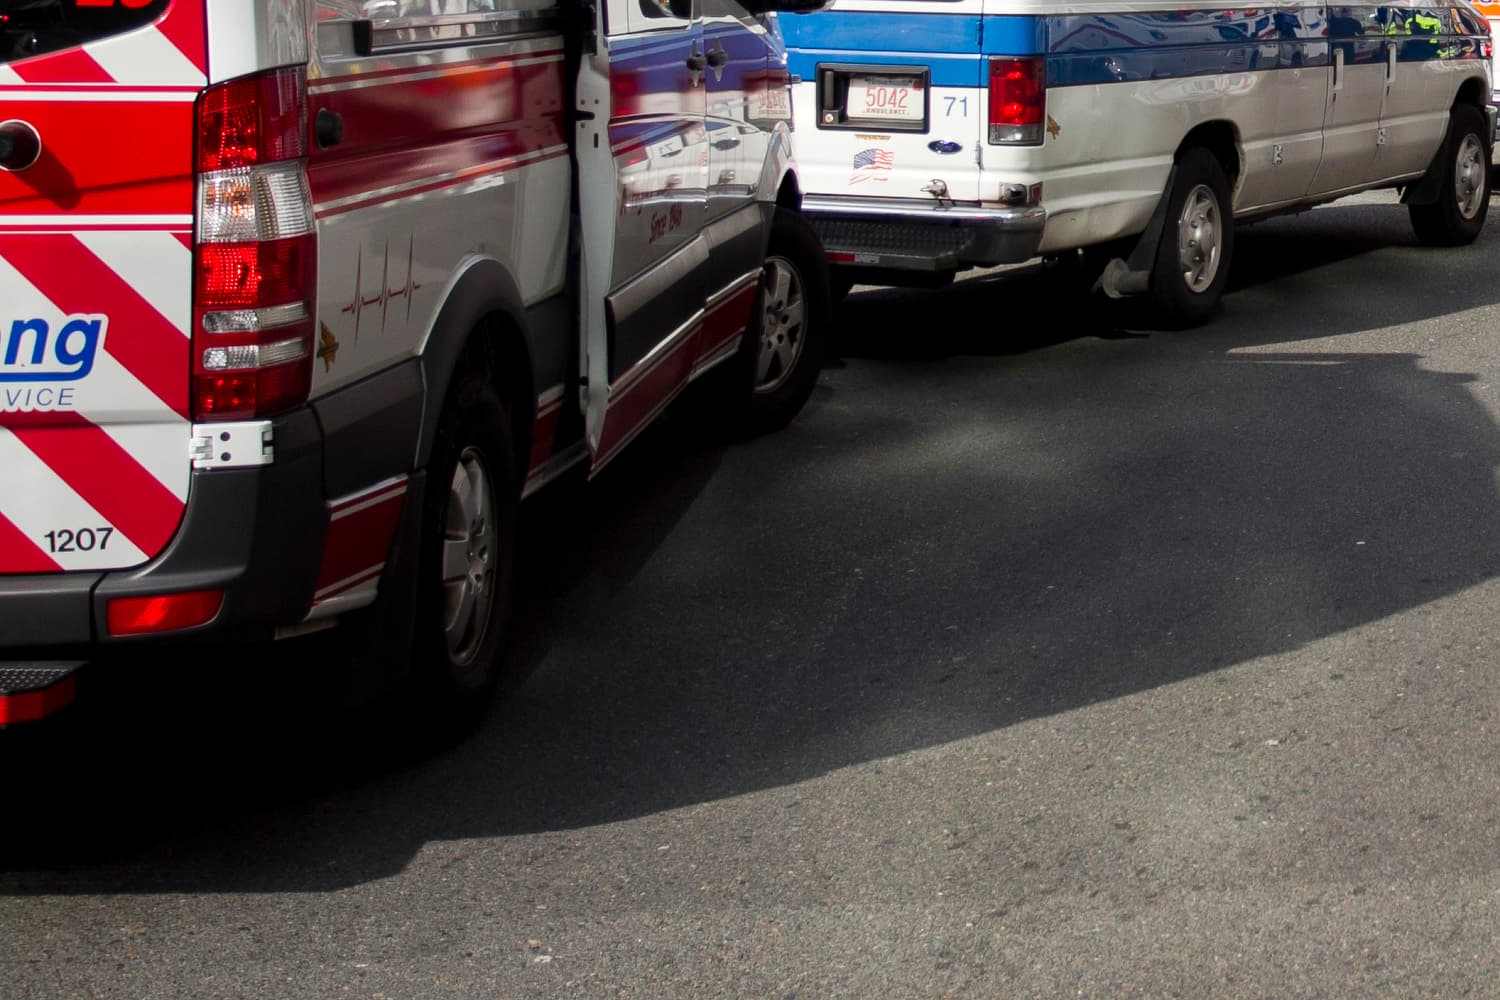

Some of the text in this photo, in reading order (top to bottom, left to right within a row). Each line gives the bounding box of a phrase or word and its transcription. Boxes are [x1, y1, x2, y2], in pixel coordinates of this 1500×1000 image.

[866, 87, 908, 109] 5042
[943, 96, 968, 117] 71
[44, 527, 114, 553] 1207
